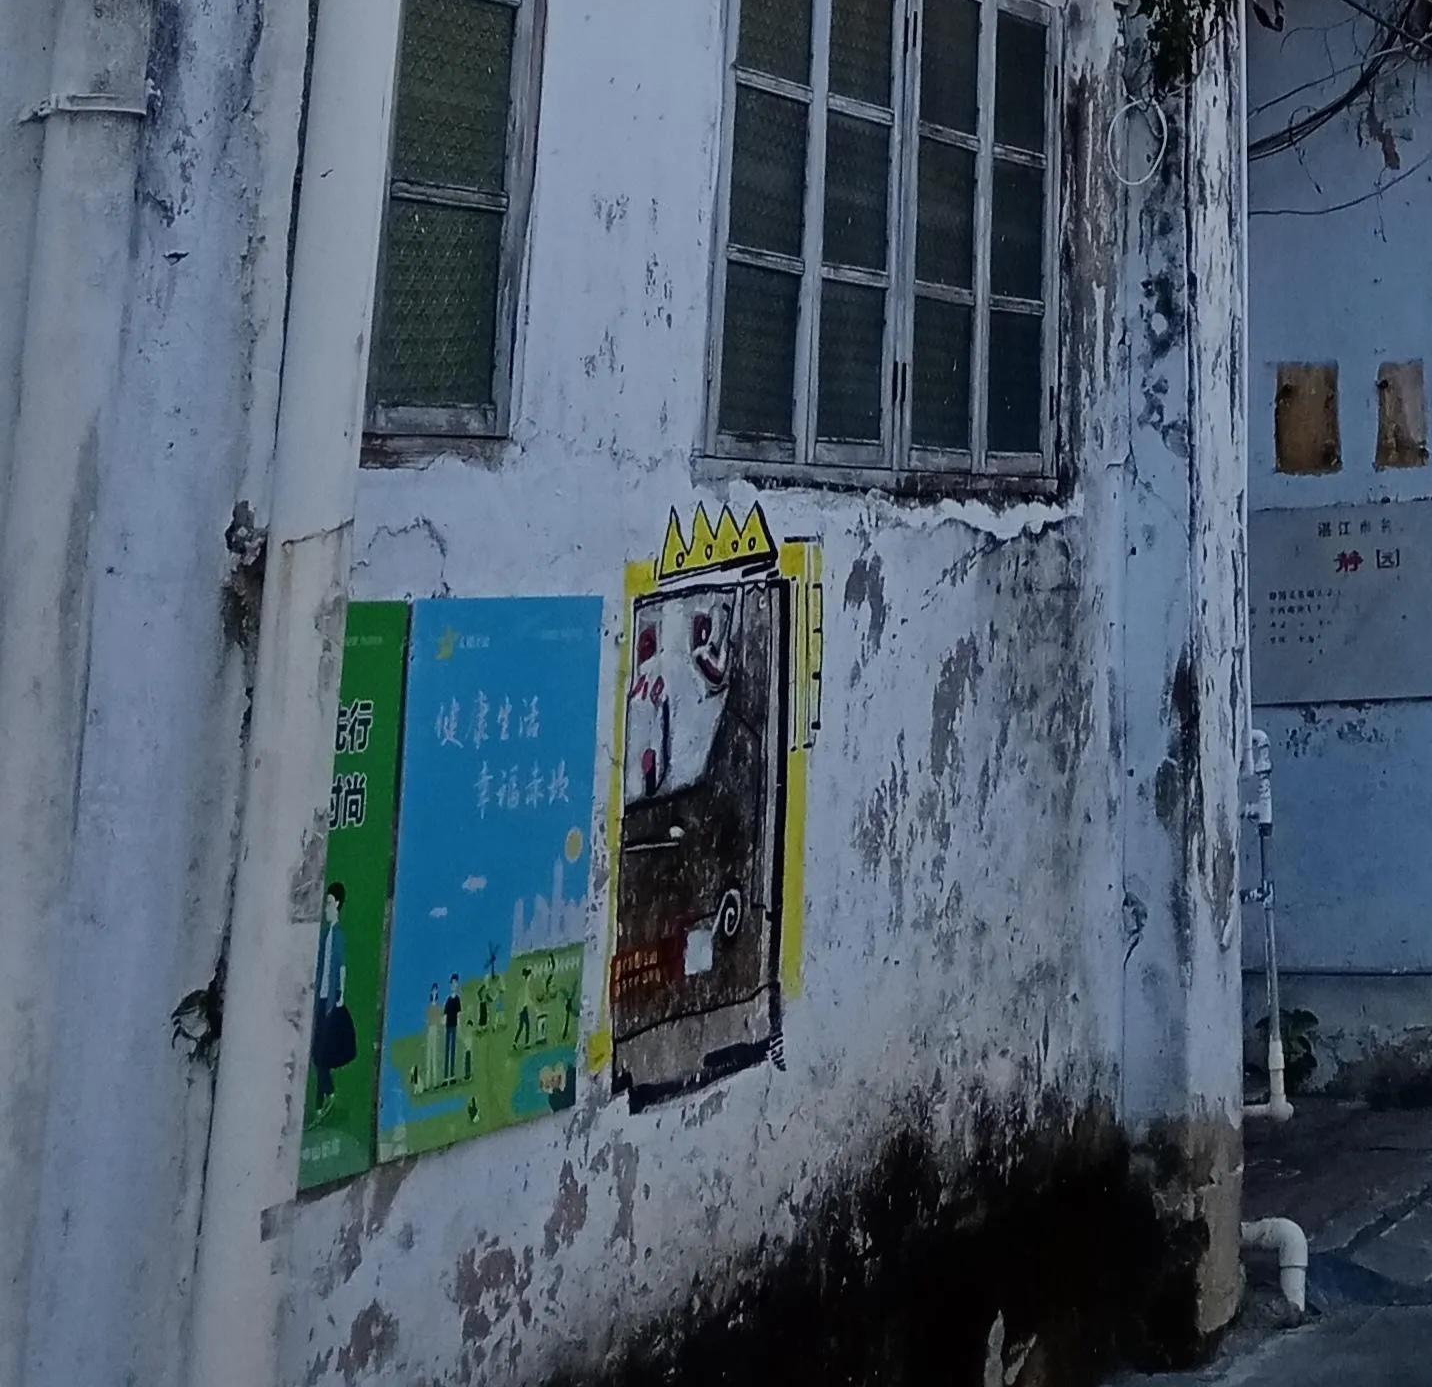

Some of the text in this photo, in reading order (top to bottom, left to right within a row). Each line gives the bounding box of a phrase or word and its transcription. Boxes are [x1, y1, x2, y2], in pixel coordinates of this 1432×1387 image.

[1333, 548, 1400, 573] 静园
[434, 689, 540, 750] 健康生活
